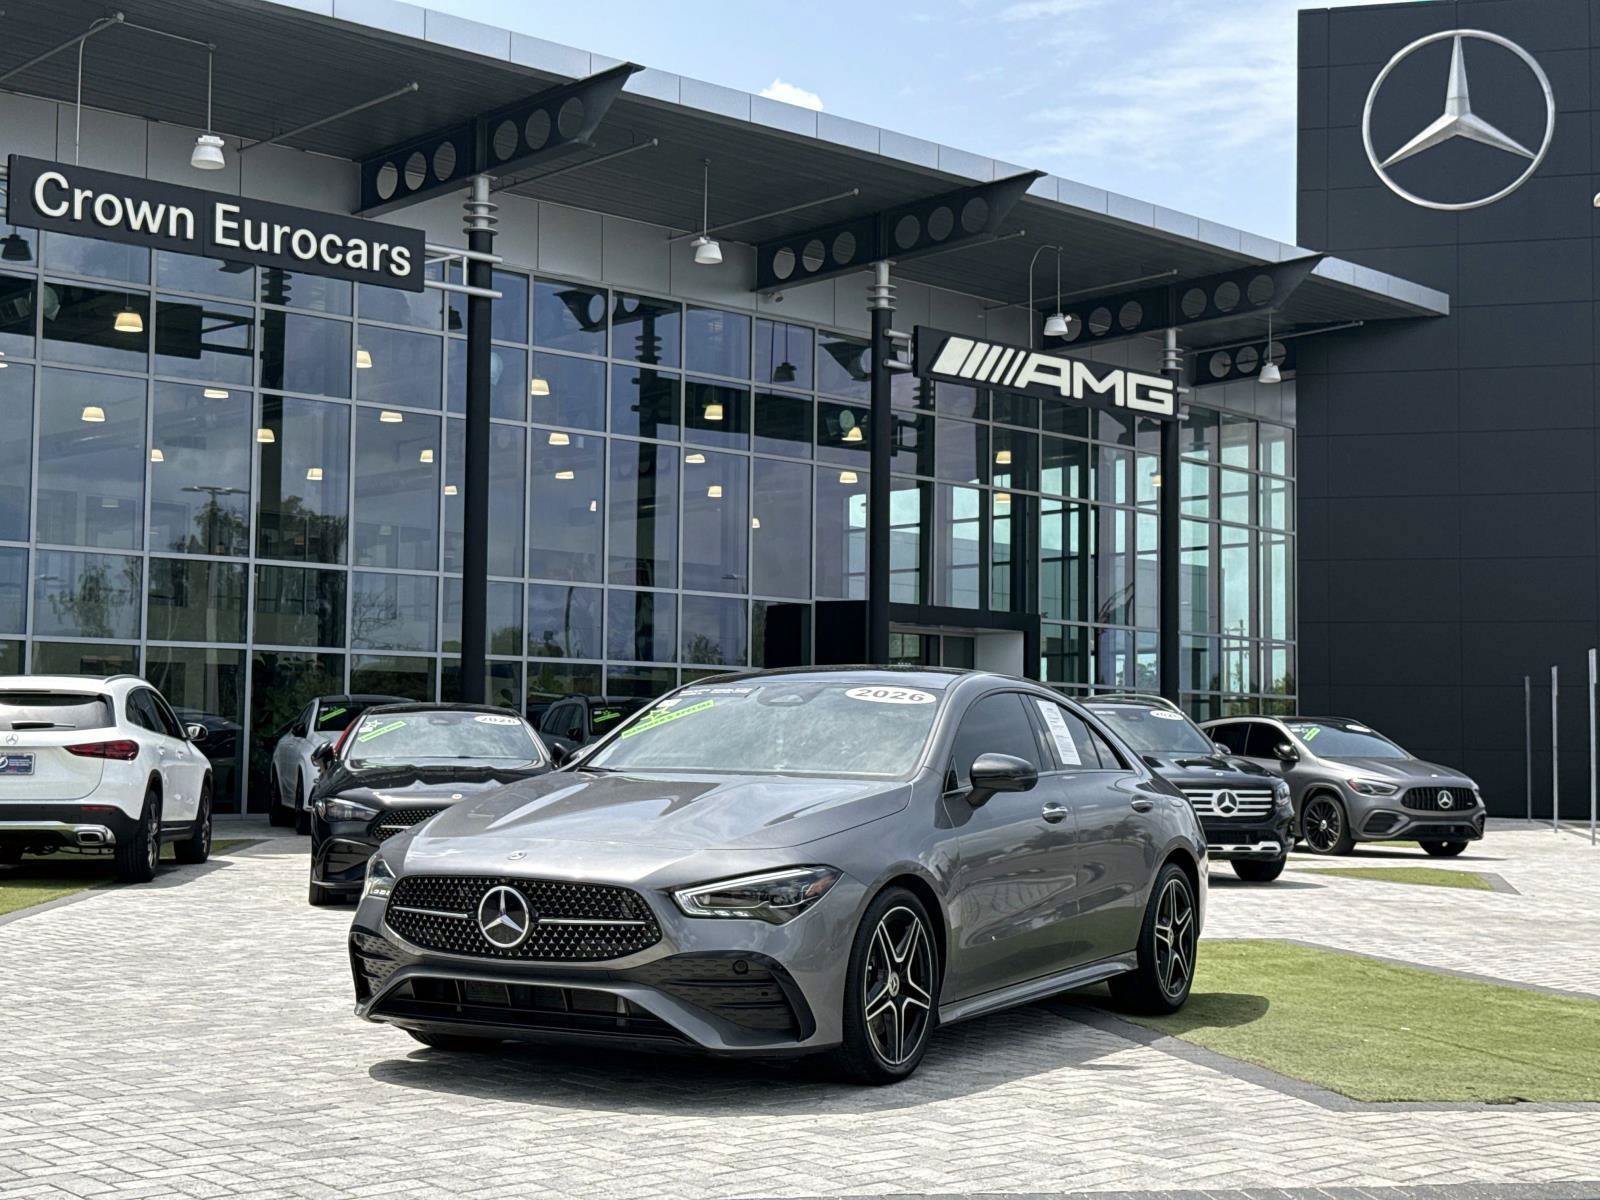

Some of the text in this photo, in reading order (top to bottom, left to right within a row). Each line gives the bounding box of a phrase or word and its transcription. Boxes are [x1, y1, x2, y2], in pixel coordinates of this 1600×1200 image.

[33, 170, 412, 278] Crown Eurocars
[1014, 351, 1175, 416] AMG
[855, 688, 926, 702] 2026
